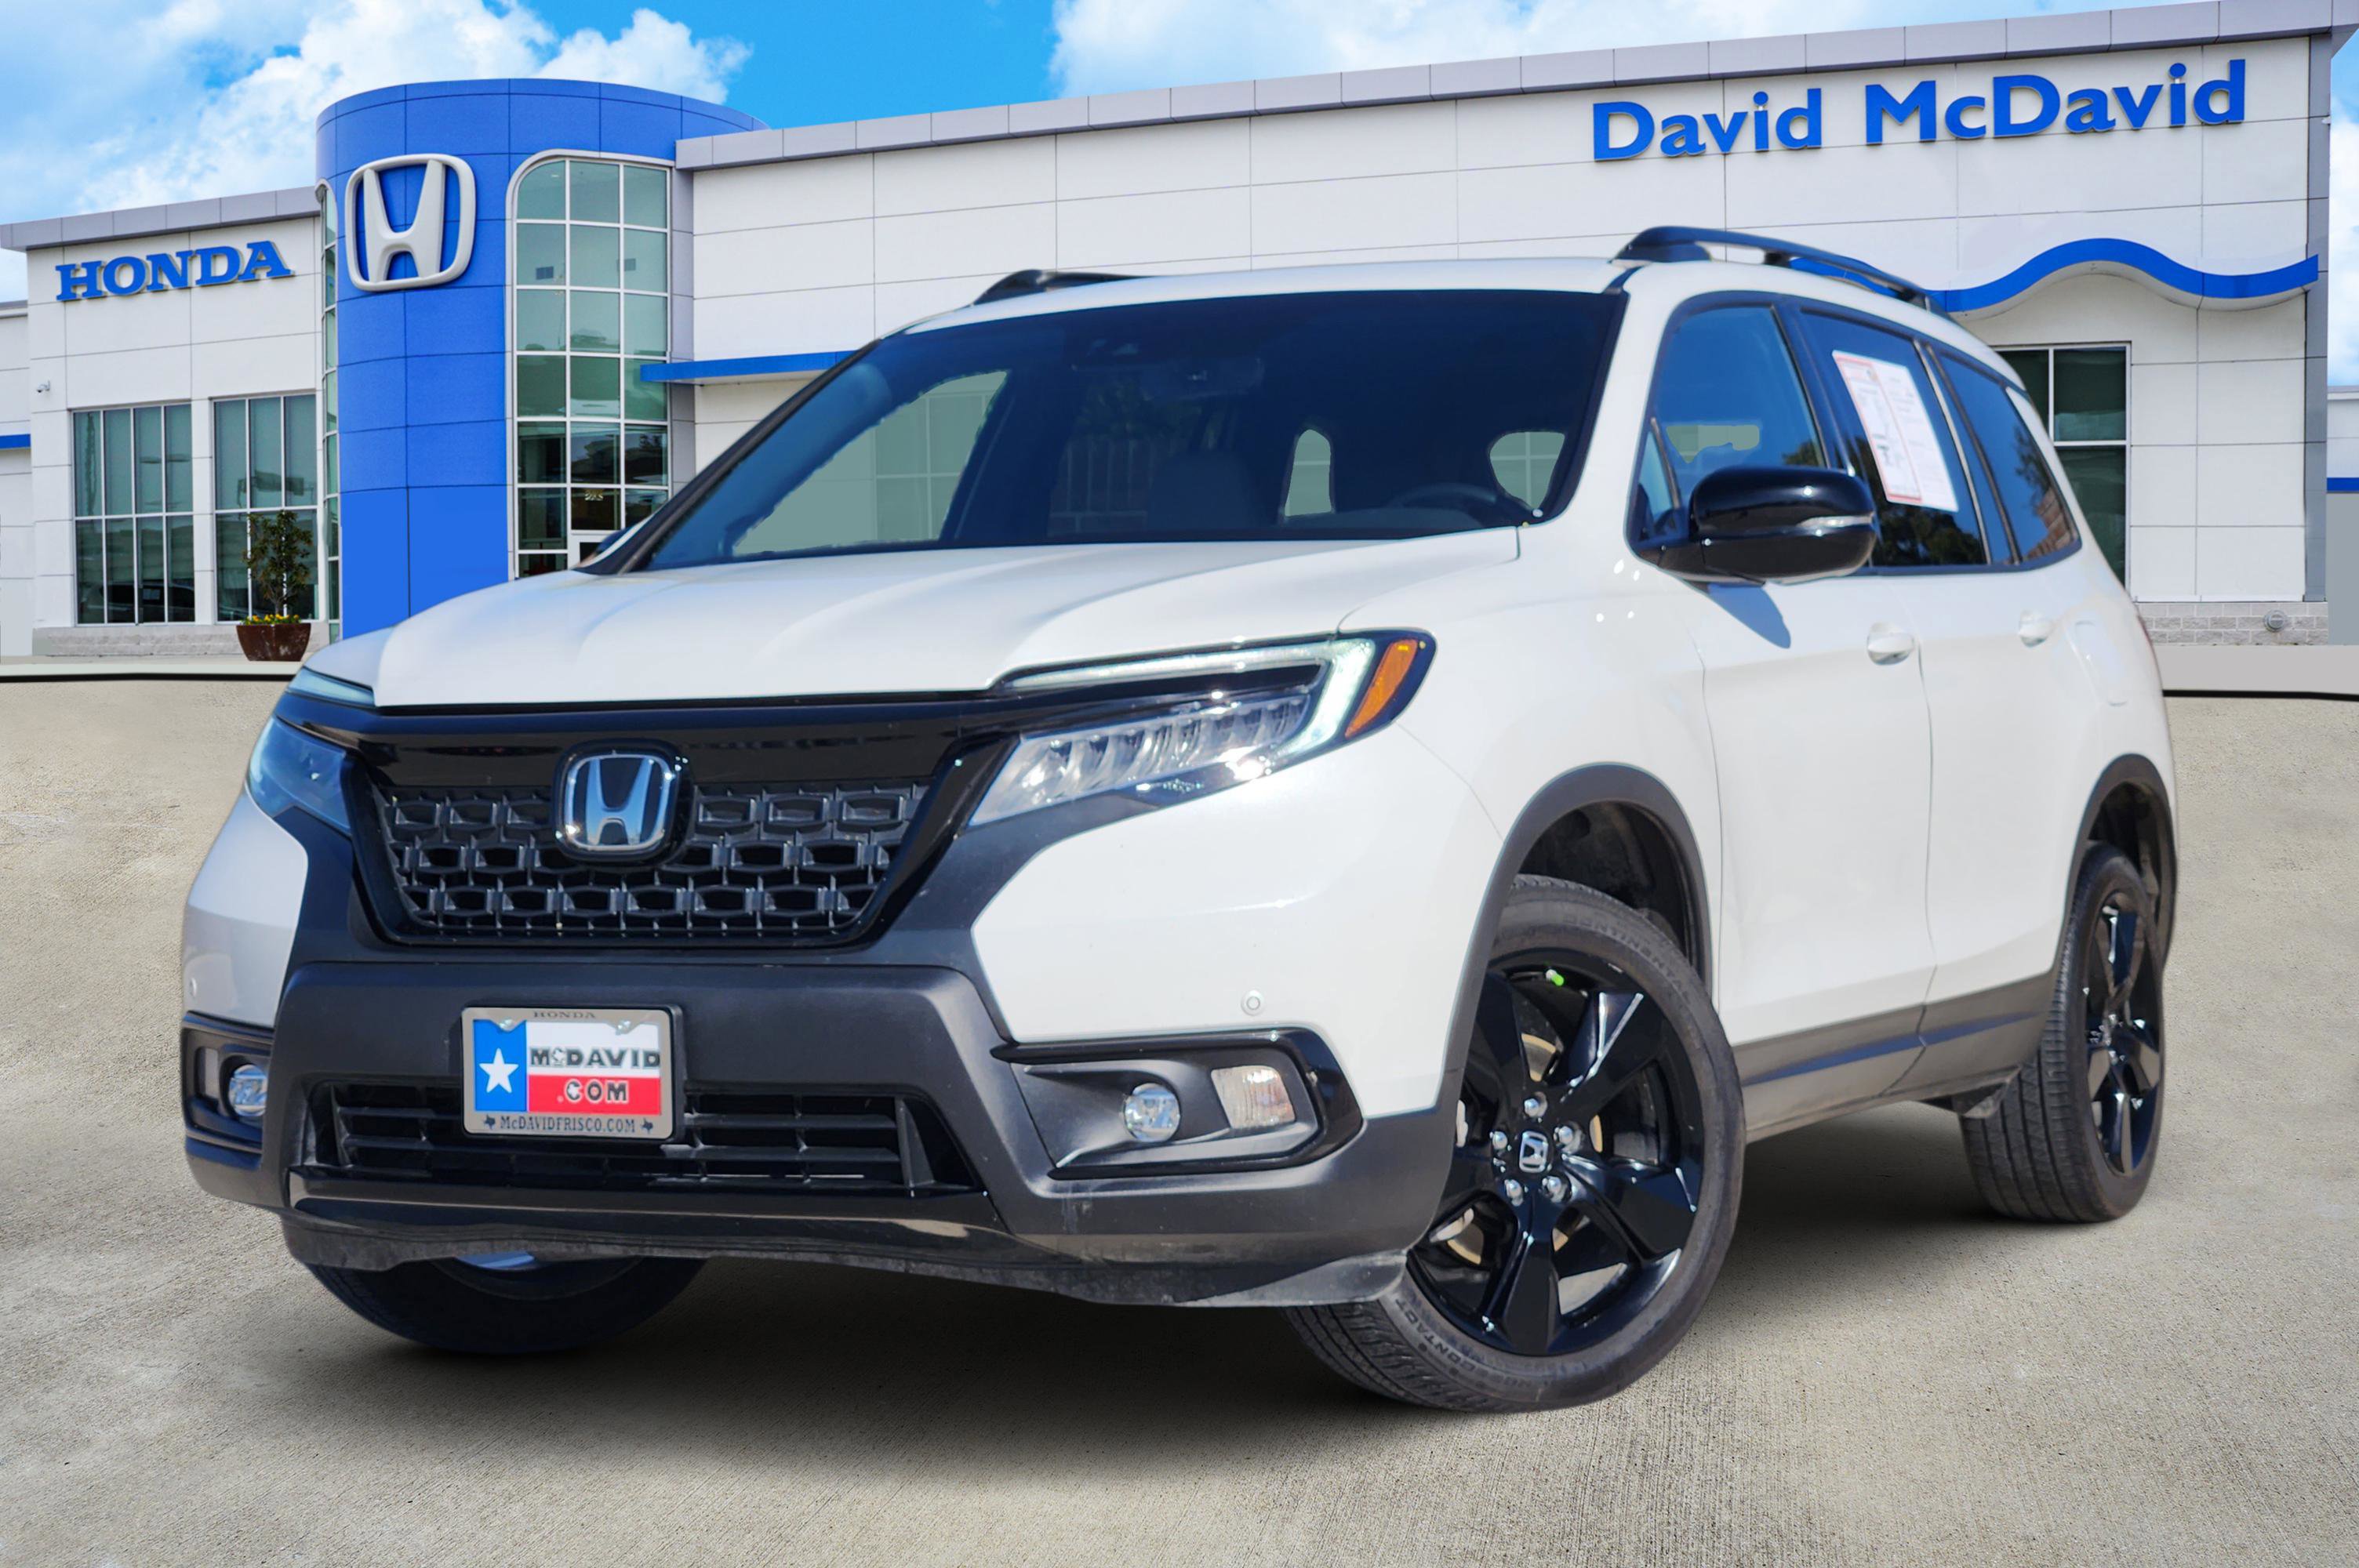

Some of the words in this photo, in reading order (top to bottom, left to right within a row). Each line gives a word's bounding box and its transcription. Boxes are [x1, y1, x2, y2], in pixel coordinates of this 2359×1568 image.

[1593, 87, 1822, 162] David
[1865, 58, 2246, 146] McDavid
[55, 240, 295, 302] HONDA
[533, 1011, 596, 1019] HONDA
[557, 1079, 630, 1104] .COM
[500, 1116, 636, 1134] McDAVIDFRISCO.COM
